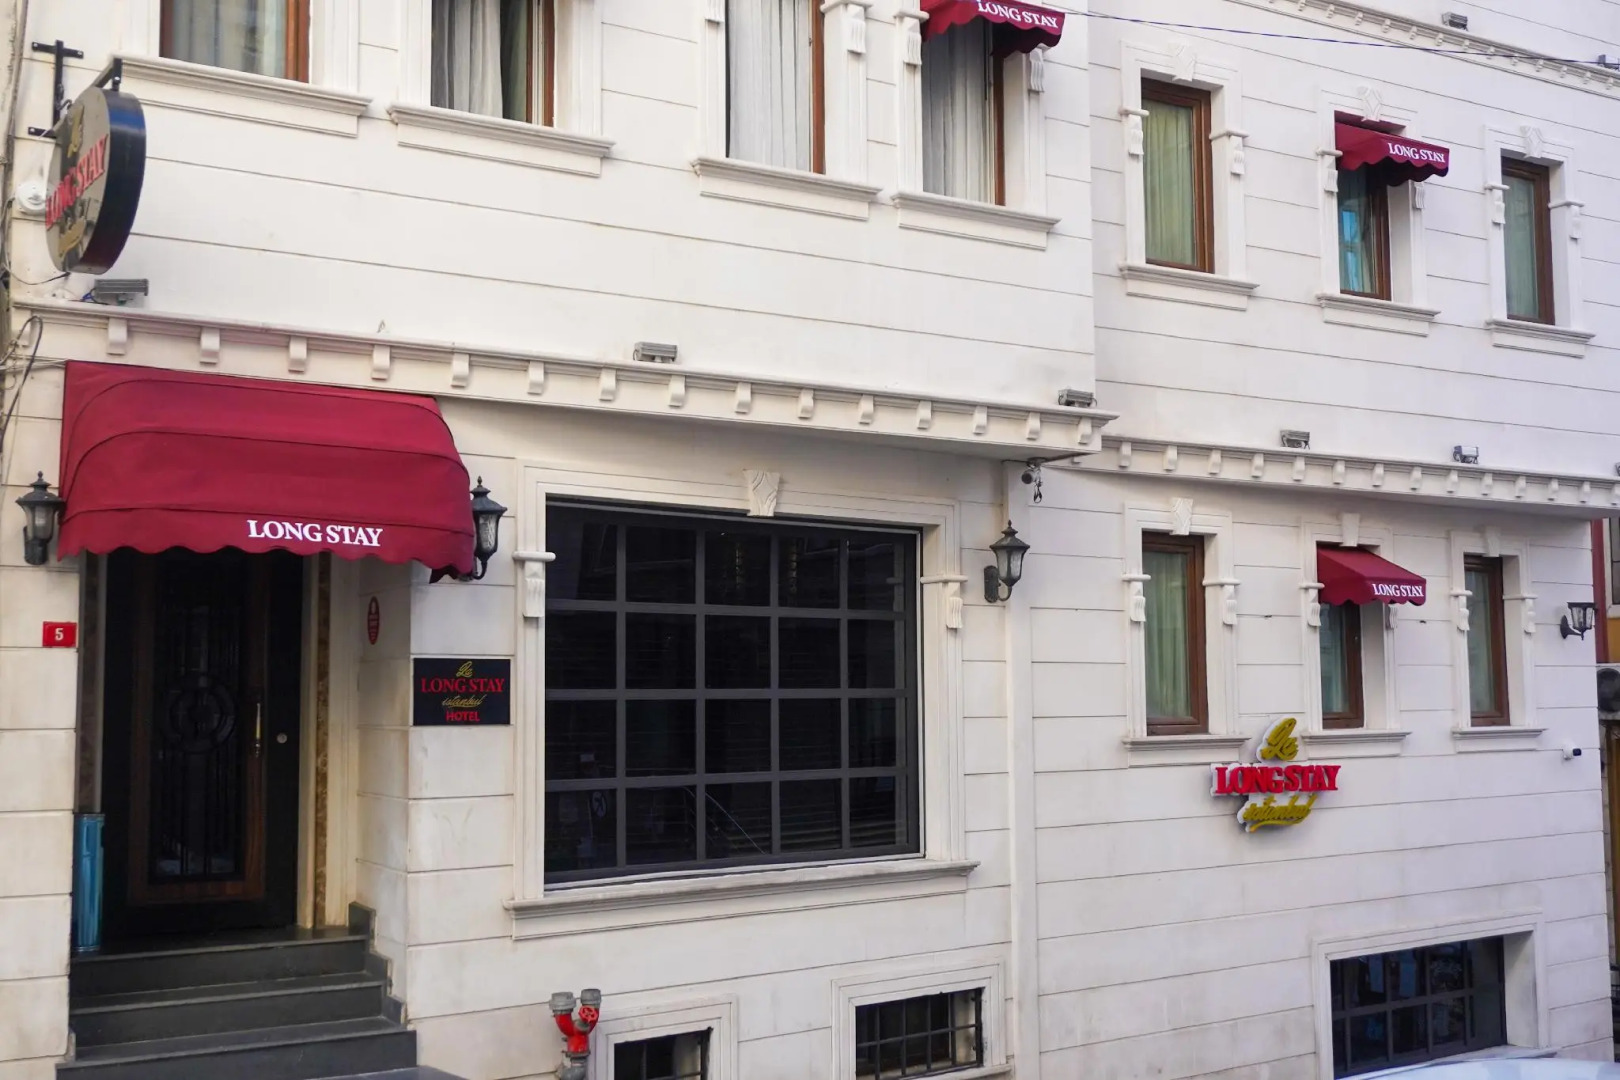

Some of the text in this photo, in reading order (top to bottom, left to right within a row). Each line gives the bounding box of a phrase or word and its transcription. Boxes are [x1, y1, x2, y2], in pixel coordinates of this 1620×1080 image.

[977, 0, 1058, 28] LONG STAY
[1387, 142, 1446, 163] LONG STAY
[76, 134, 108, 197] STAY
[247, 519, 383, 547] LONG STAY
[1372, 583, 1424, 597] LONG STAY
[55, 627, 64, 641] 5
[421, 678, 505, 693] LONG STAY
[445, 710, 481, 722] HOTEL
